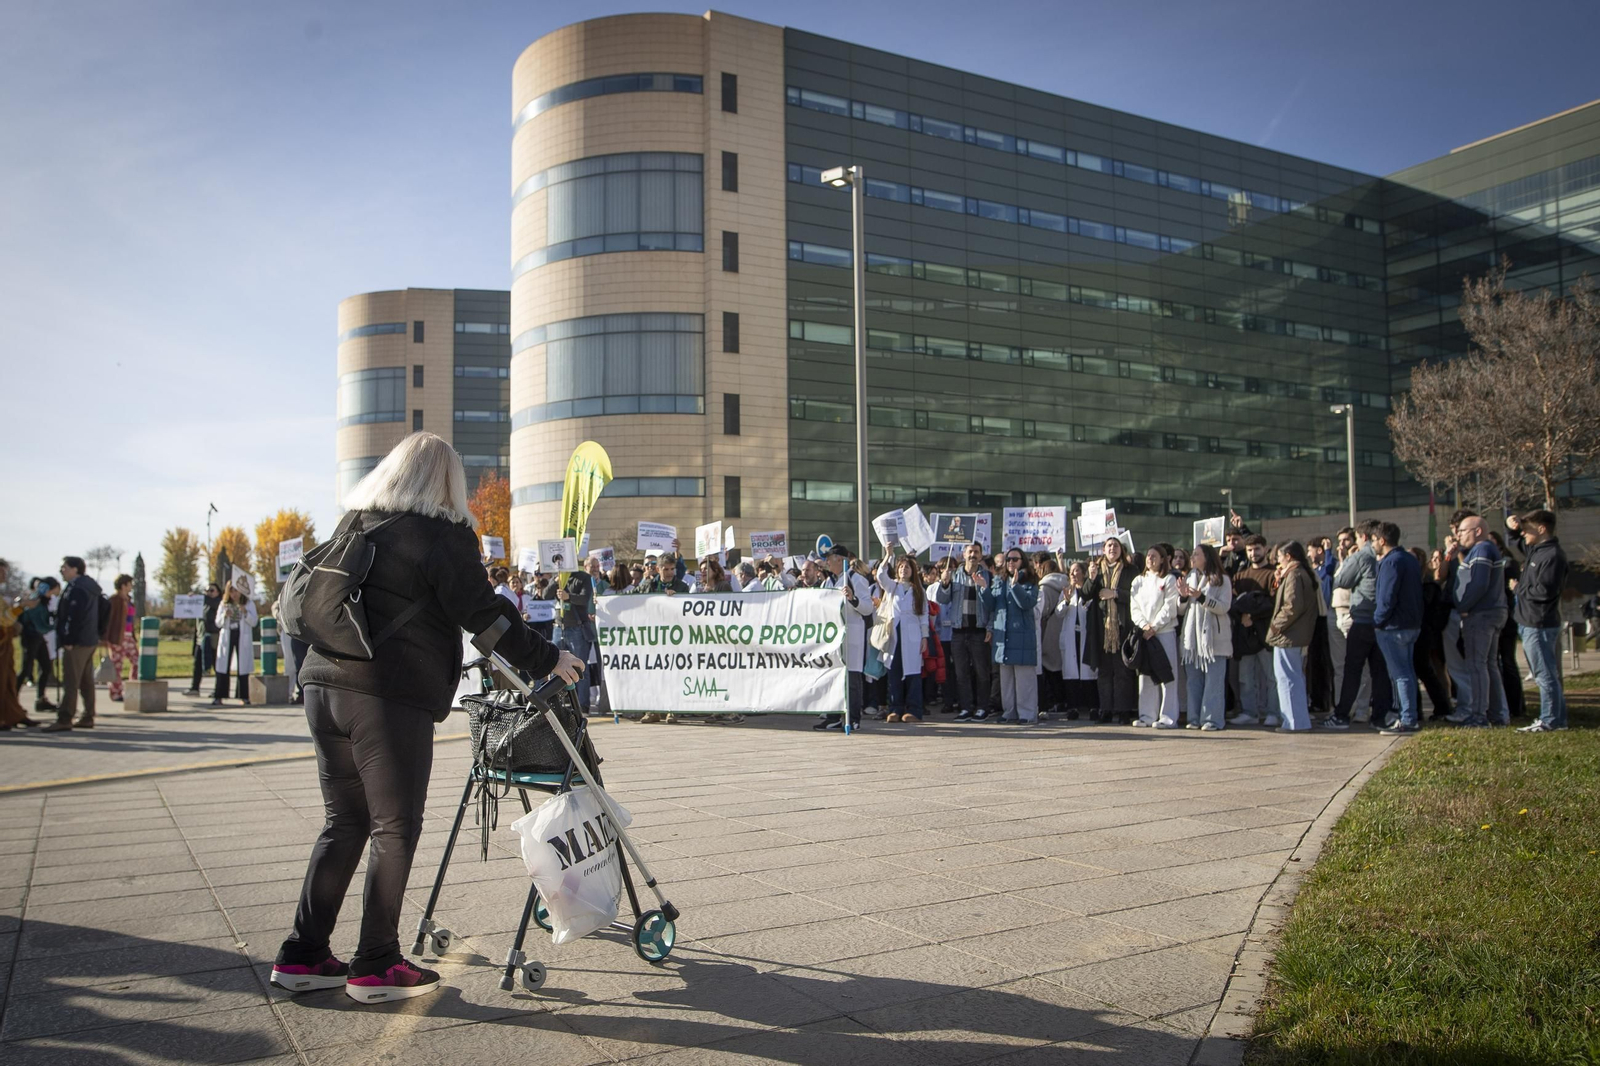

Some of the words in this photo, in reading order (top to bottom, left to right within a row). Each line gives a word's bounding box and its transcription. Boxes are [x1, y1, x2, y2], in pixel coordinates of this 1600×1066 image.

[1018, 536, 1053, 546] ESTATUTO
[682, 600, 716, 617] POR
[719, 600, 744, 617] UN
[599, 625, 684, 647] ESTATUTO
[688, 624, 754, 646] MARCO
[758, 621, 839, 645] PROPIO
[602, 653, 641, 671] PARA
[645, 652, 693, 671] LAS/OS
[682, 675, 728, 699] SMA
